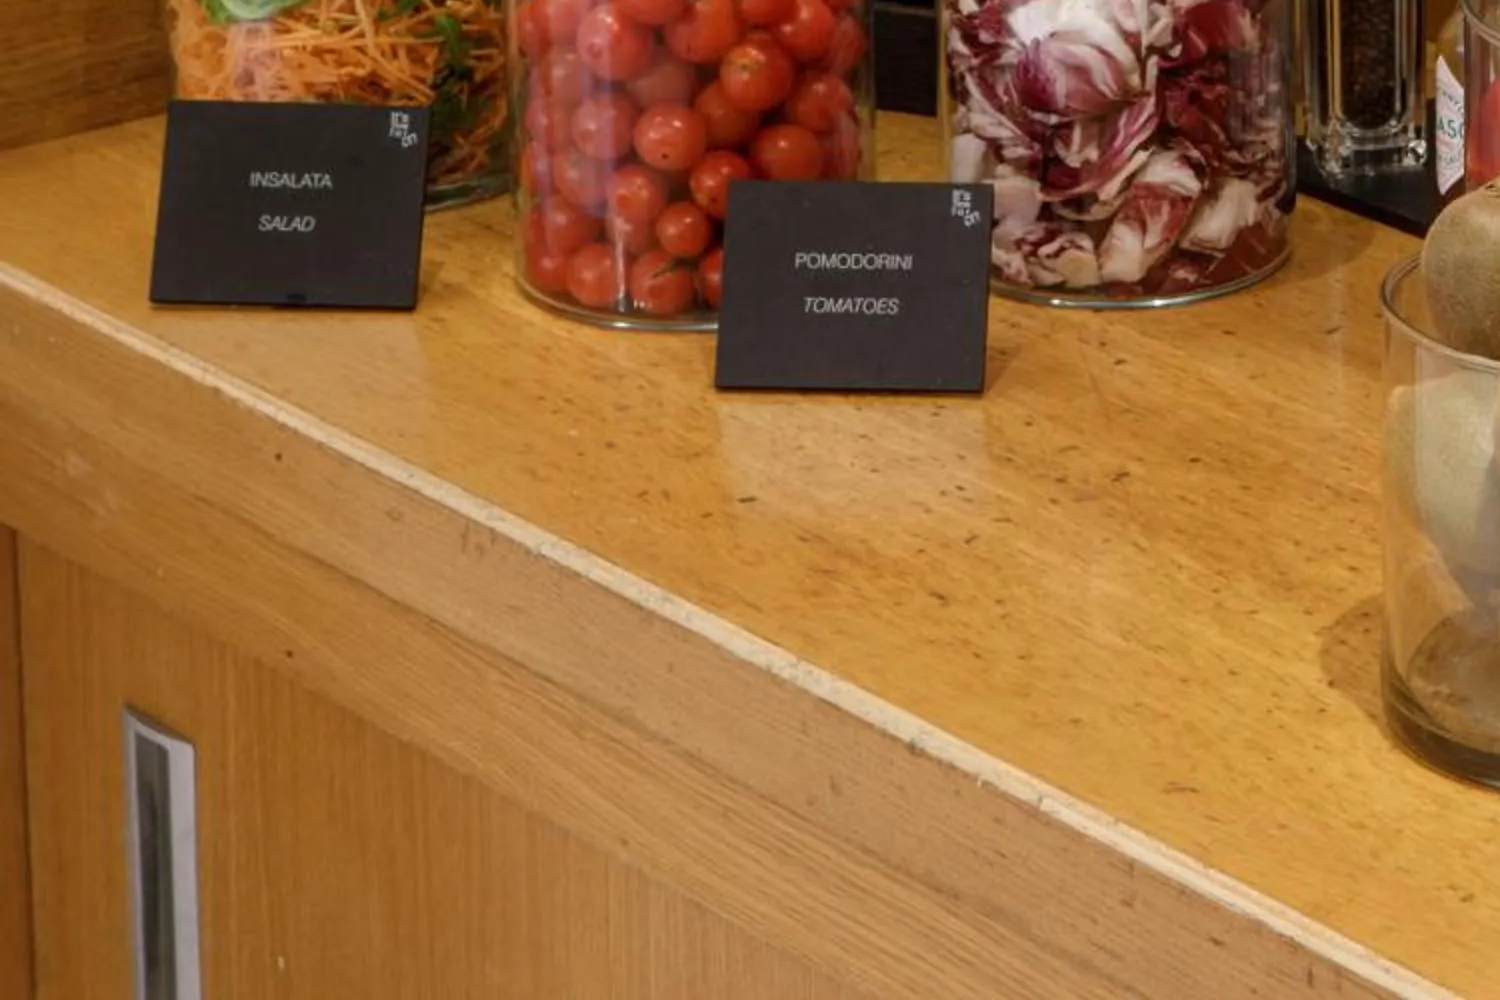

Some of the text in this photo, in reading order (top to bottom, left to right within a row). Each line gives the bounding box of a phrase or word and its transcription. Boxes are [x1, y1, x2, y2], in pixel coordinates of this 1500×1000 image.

[249, 170, 333, 190] INSALATA
[257, 214, 317, 233] SALAD
[794, 251, 914, 271] POMODORINI
[803, 296, 900, 315] TOMATOES
